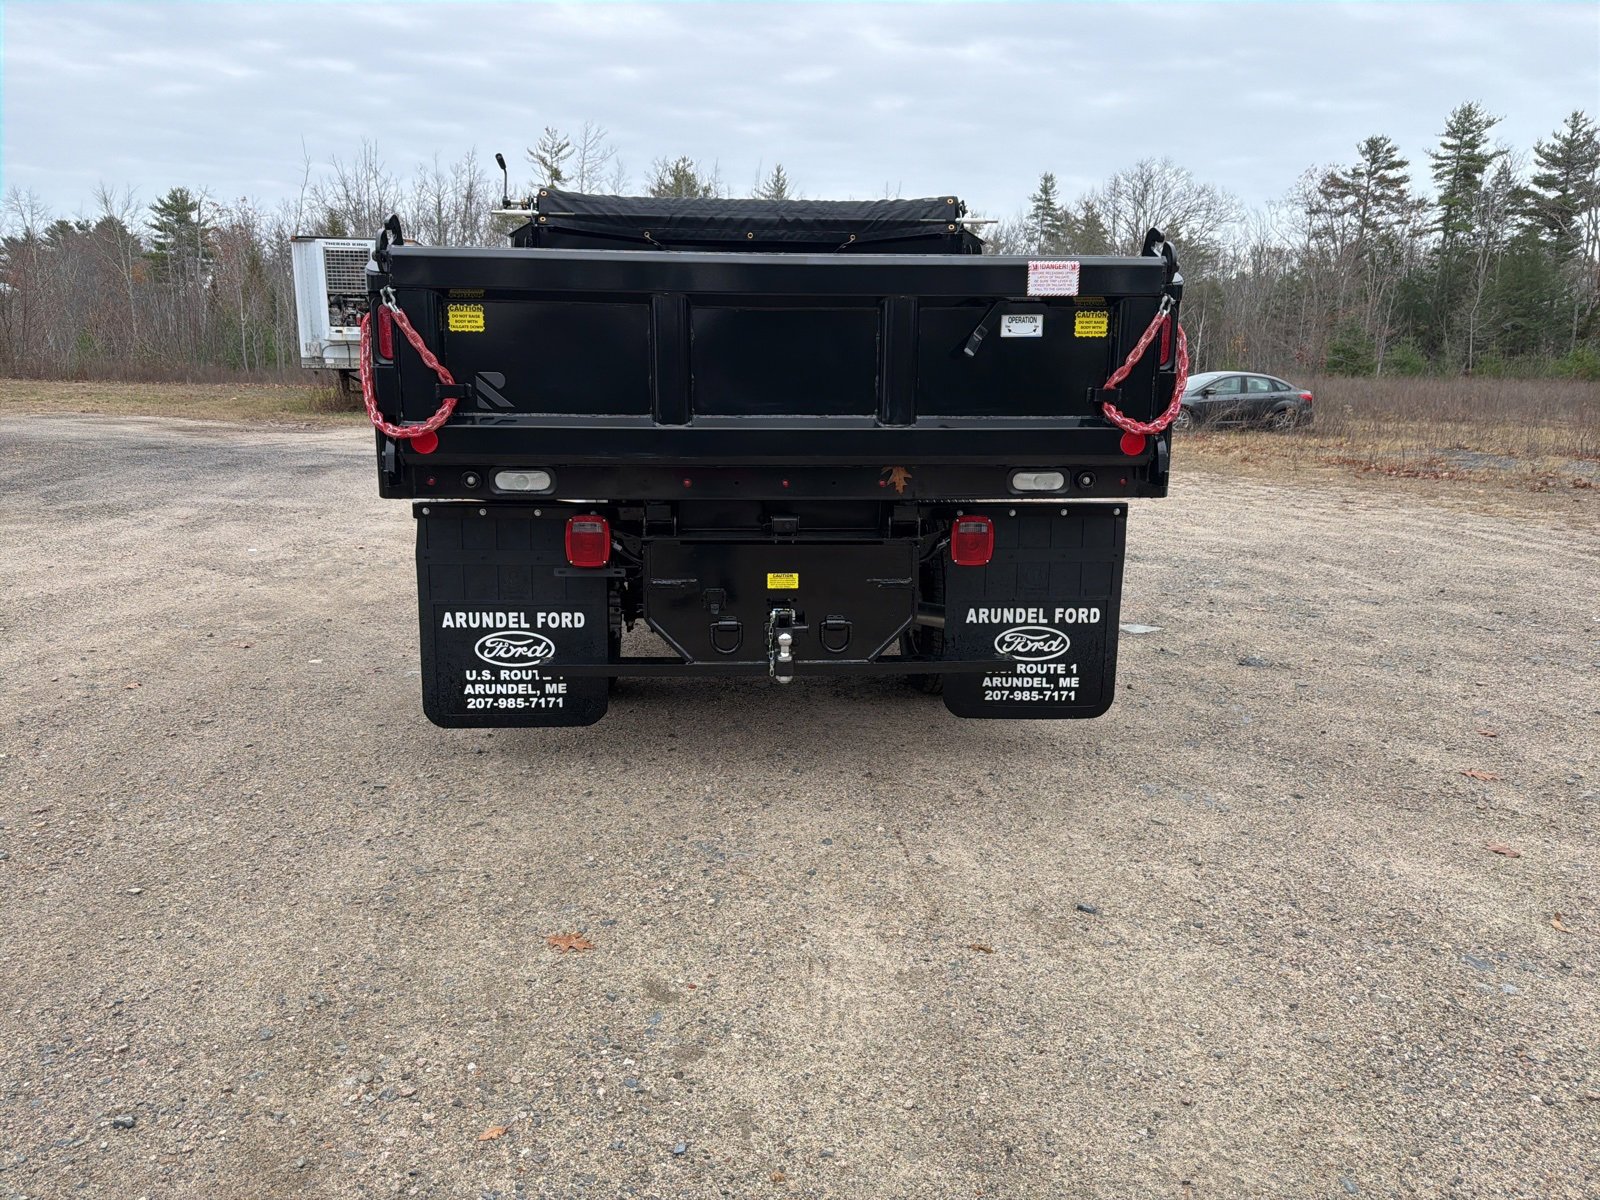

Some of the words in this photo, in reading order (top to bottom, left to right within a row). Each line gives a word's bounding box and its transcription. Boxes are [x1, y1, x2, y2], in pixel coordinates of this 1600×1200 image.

[442, 612, 530, 628] ARUNDEL
[537, 612, 585, 628] FORD
[966, 608, 1048, 624] ARUNDEL
[1054, 608, 1100, 624] FORD
[483, 638, 548, 658] Ford
[1002, 632, 1064, 652] Ford
[466, 670, 495, 680] U.S.
[500, 670, 552, 680] ROUT
[1016, 664, 1066, 674] ROUTE
[1070, 664, 1077, 674] 1
[982, 677, 1054, 689] ARUNDEL,
[1059, 677, 1079, 688] ME
[464, 684, 540, 696] ARUNDEL,
[545, 684, 567, 694] ME
[984, 690, 1076, 700] 207-985-7171
[467, 698, 563, 708] 207-985-7171
